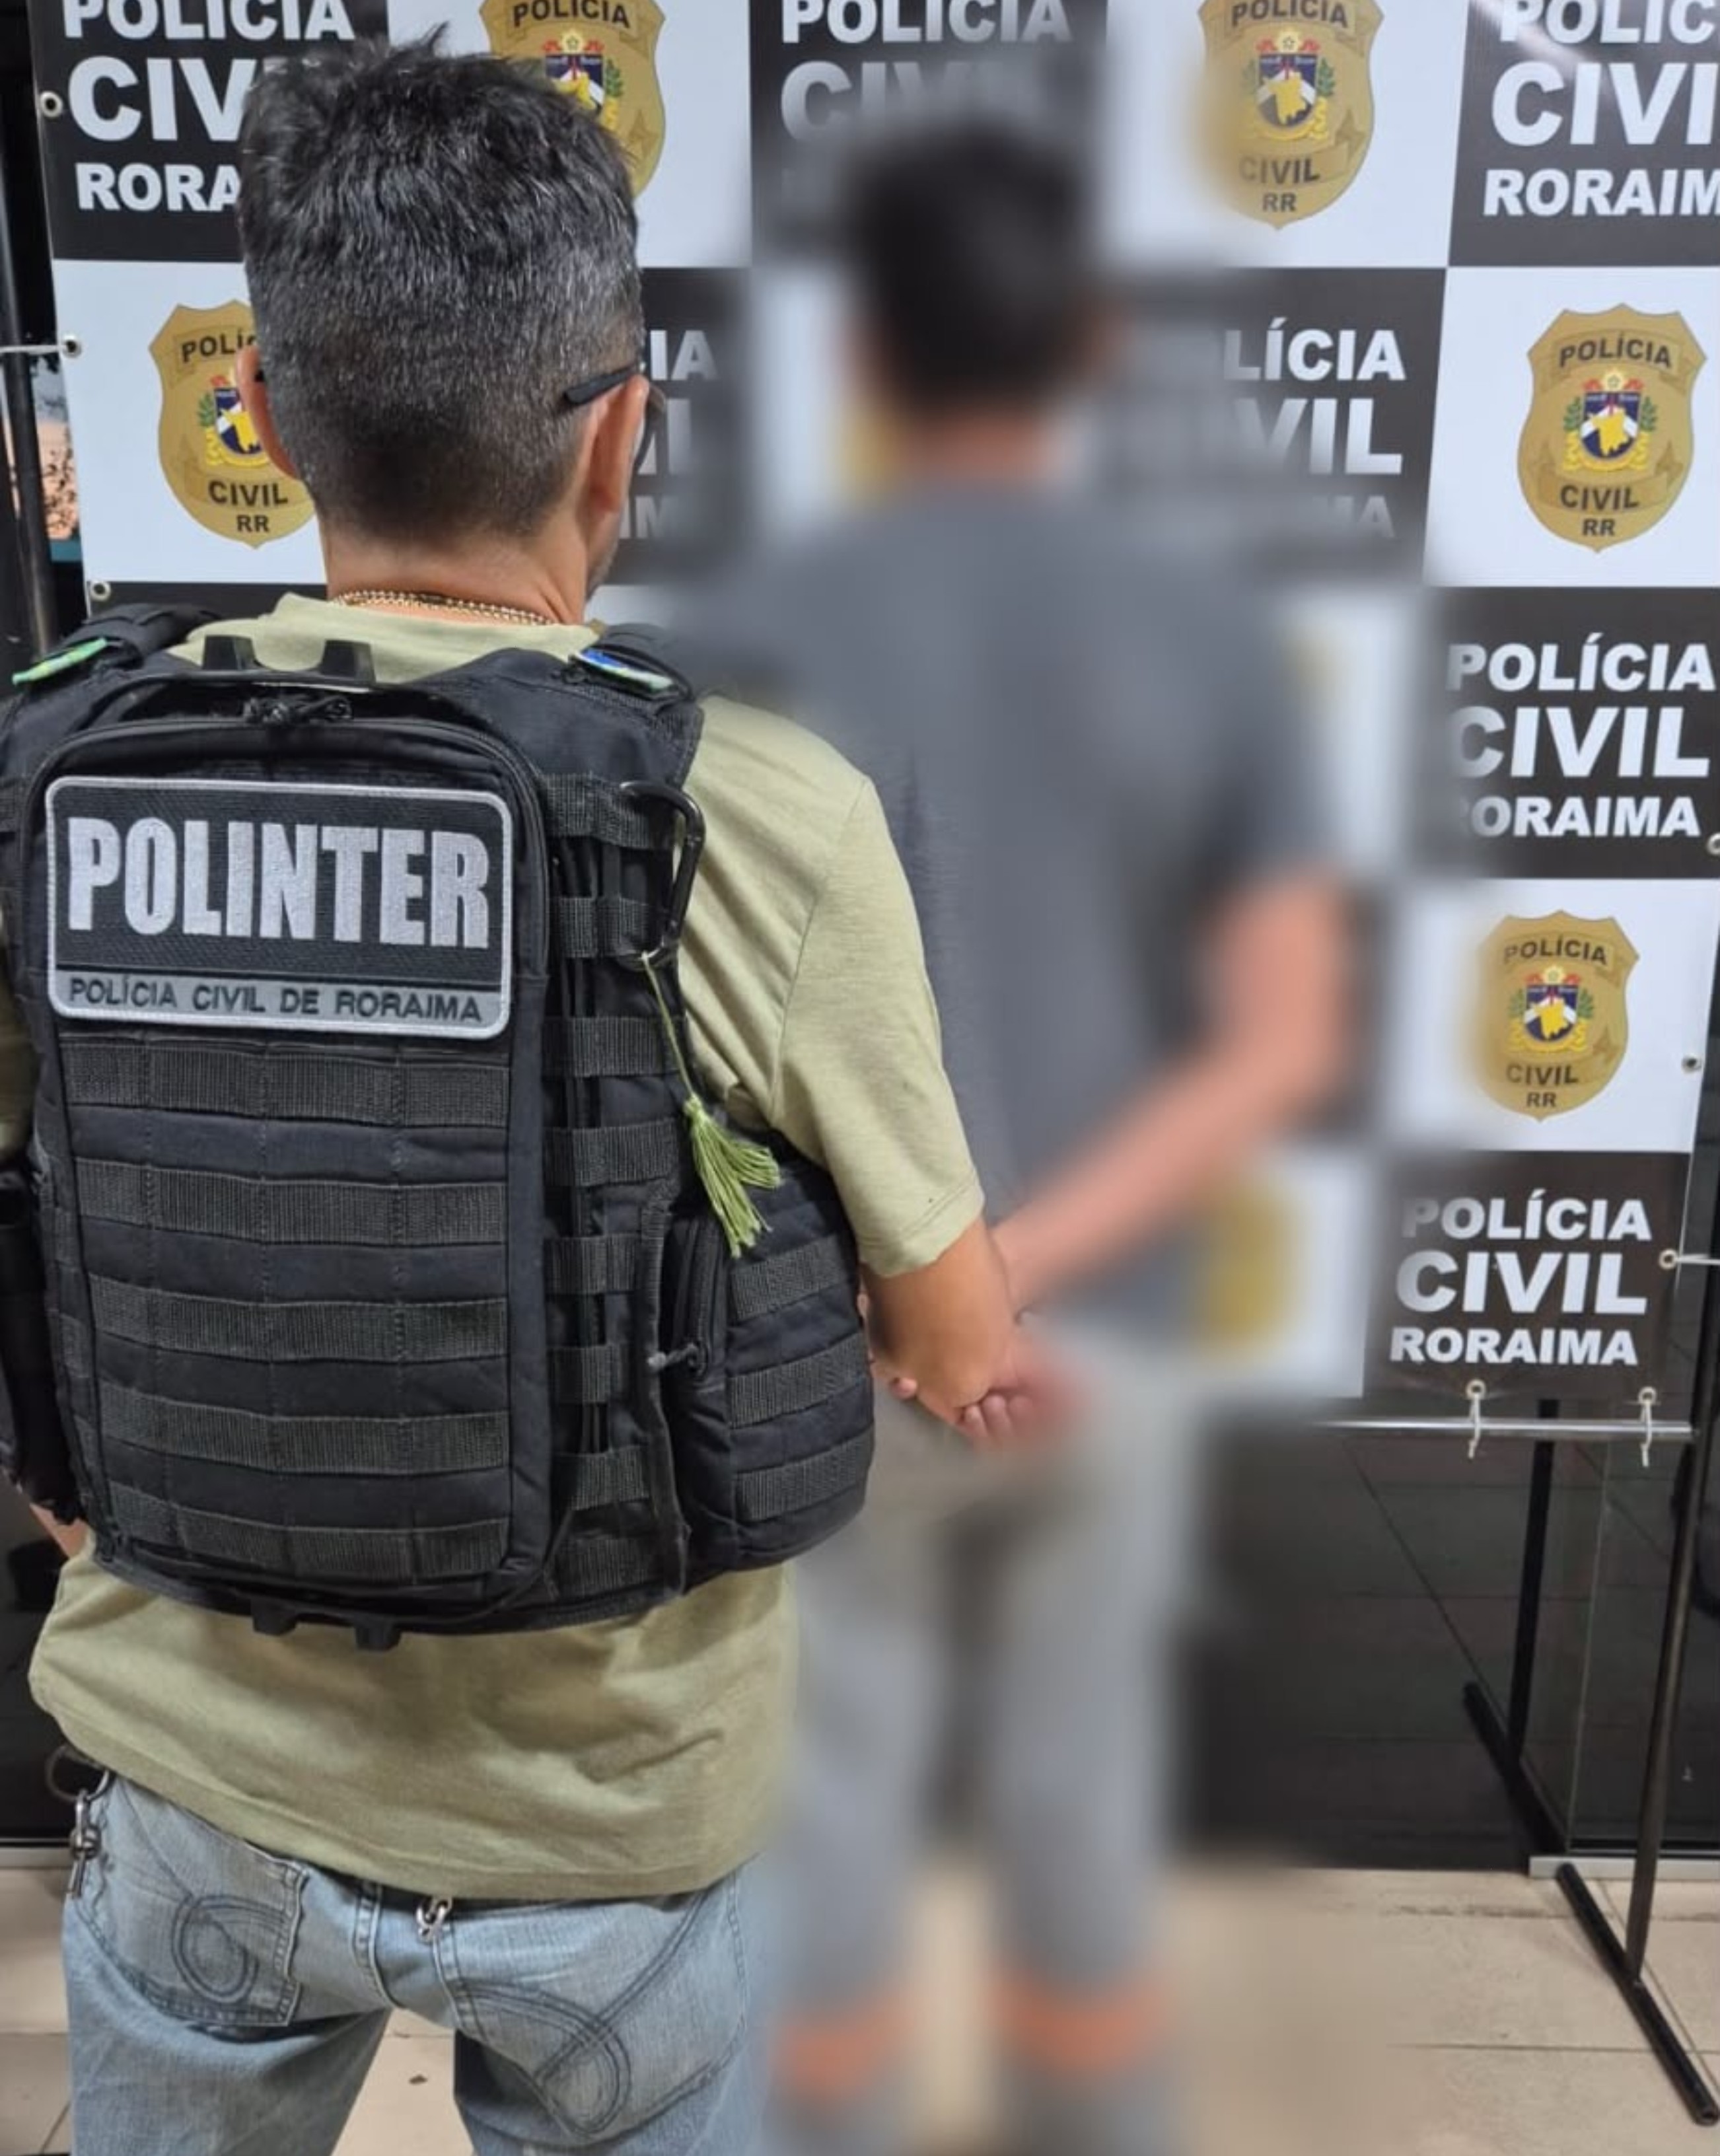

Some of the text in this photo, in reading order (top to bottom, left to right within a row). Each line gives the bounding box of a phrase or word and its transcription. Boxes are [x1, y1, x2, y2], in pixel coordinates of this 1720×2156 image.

[68, 55, 257, 142] CIV
[75, 162, 240, 212] RORA
[1238, 155, 1321, 184] CIVIL
[1262, 192, 1297, 212] RR
[182, 328, 257, 363] POLÍ
[1223, 317, 1407, 381] LÍCIA
[1559, 331, 1672, 369] POLÍCIA
[1233, 398, 1402, 475] VIL
[207, 480, 289, 507] CIVIL
[1559, 484, 1640, 511] CIVIL
[236, 515, 270, 532] RR
[1582, 518, 1616, 536] RR
[1445, 631, 1717, 692] POLÍCIA
[1449, 705, 1711, 778] CIVIL
[67, 816, 489, 949] POLINTER
[1503, 935, 1608, 966] POLÍCIA
[69, 976, 482, 1023] POLÍCIA CIVIL DE RORAIMA
[1506, 1063, 1579, 1086] CIVIL
[1526, 1092, 1558, 1108] RR
[1401, 1188, 1652, 1240] POLÍCIA
[1396, 1250, 1647, 1314] CIVIL
[1390, 1328, 1638, 1366] RORAIMA
